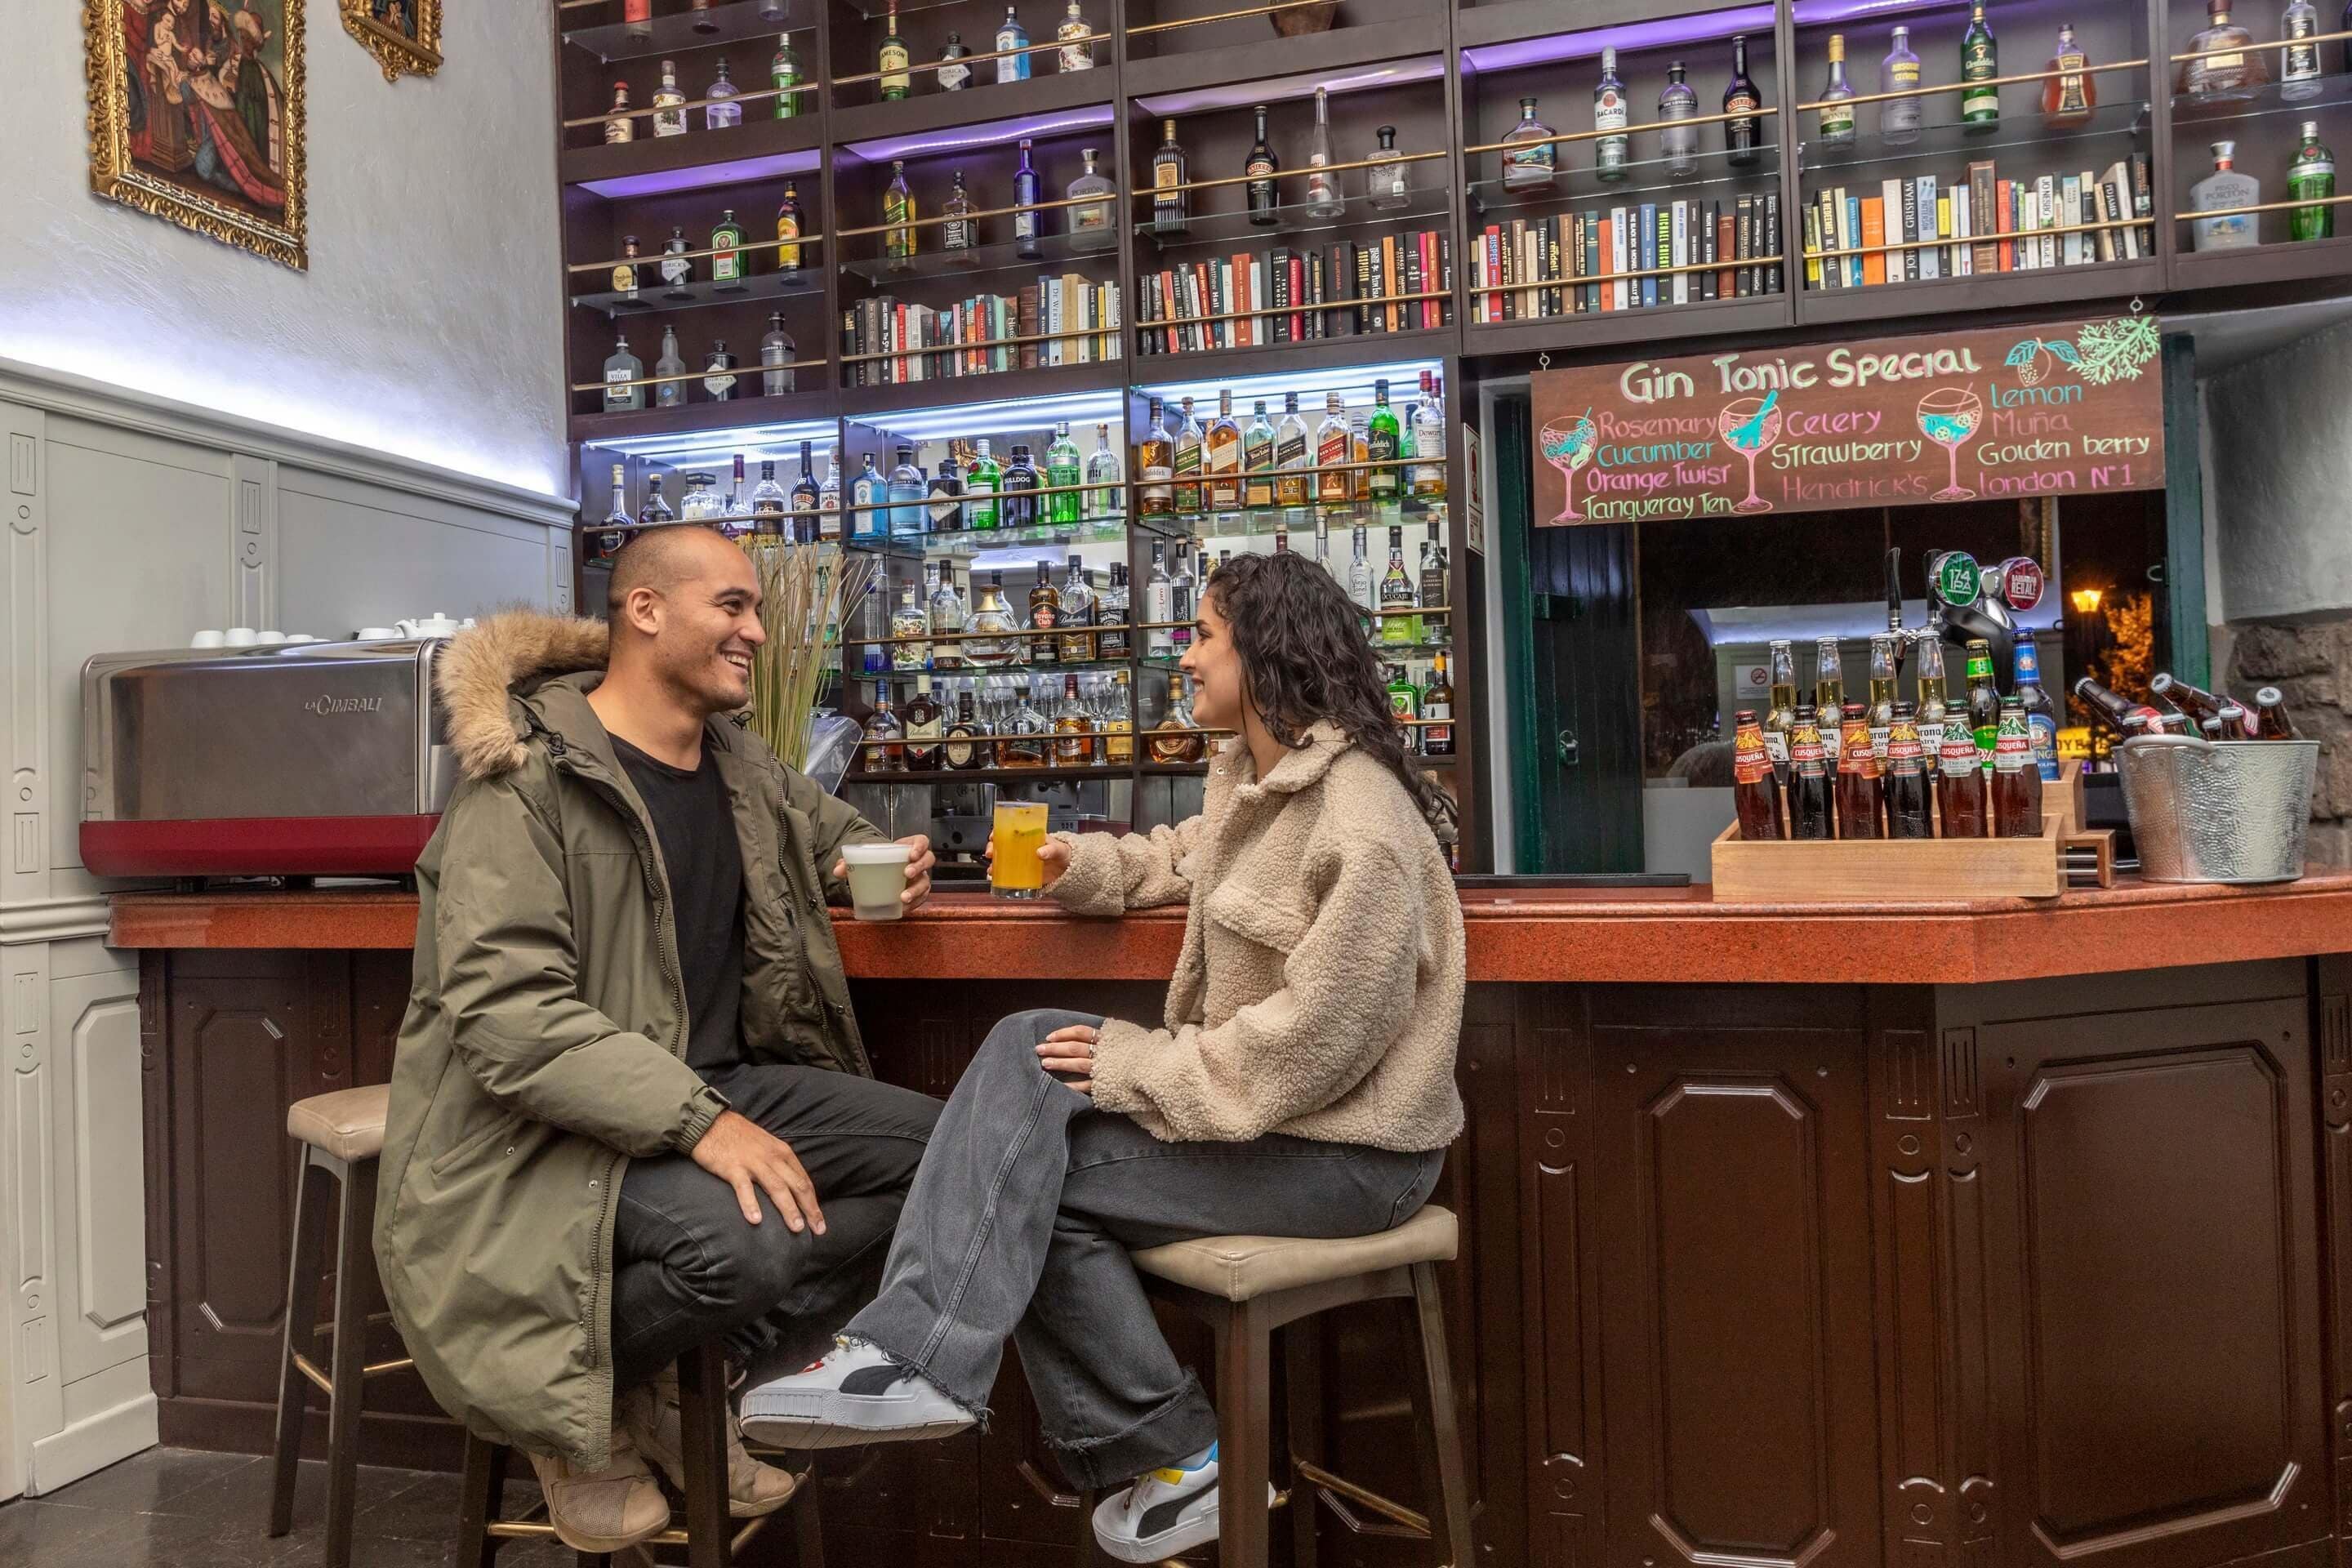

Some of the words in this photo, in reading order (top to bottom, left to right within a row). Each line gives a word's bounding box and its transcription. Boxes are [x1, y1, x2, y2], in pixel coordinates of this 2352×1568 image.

[1822, 189, 1832, 203] THE
[2042, 179, 2049, 189] JO
[1823, 203, 1833, 234] REDEEMED
[1905, 182, 1914, 228] GRISHAM
[2106, 194, 2118, 217] JAMES
[1659, 212, 1668, 243] MICHAEL
[1489, 234, 1498, 266] SUSPECT
[1538, 227, 1547, 261] frequency
[1549, 240, 1559, 271] rendell
[1659, 244, 1669, 268] CRICHT
[1209, 260, 1218, 290] Matthew
[1359, 251, 1370, 281] SUSPICION
[1906, 251, 1914, 269] JOH
[1212, 292, 1220, 308] Hall
[1620, 363, 1694, 403] Gin
[1713, 354, 1819, 394] Tonic
[1826, 347, 1982, 387] Special
[1597, 411, 1717, 440] Rosemary
[1787, 410, 1882, 437] Celery
[1330, 443, 1344, 452] LABEL
[1597, 440, 1717, 468] Cucumber
[1771, 439, 1922, 469] Strawberry
[1977, 439, 2071, 466] Golden
[2083, 435, 2150, 456] berry
[1587, 466, 1673, 497] Orange
[1673, 461, 1731, 487] Twist
[1581, 495, 1694, 522] Tanqueray
[1699, 492, 1733, 515] Ten
[305, 702, 316, 710] LA
[316, 694, 383, 715] CIMBALI
[1918, 728, 1941, 737] rona
